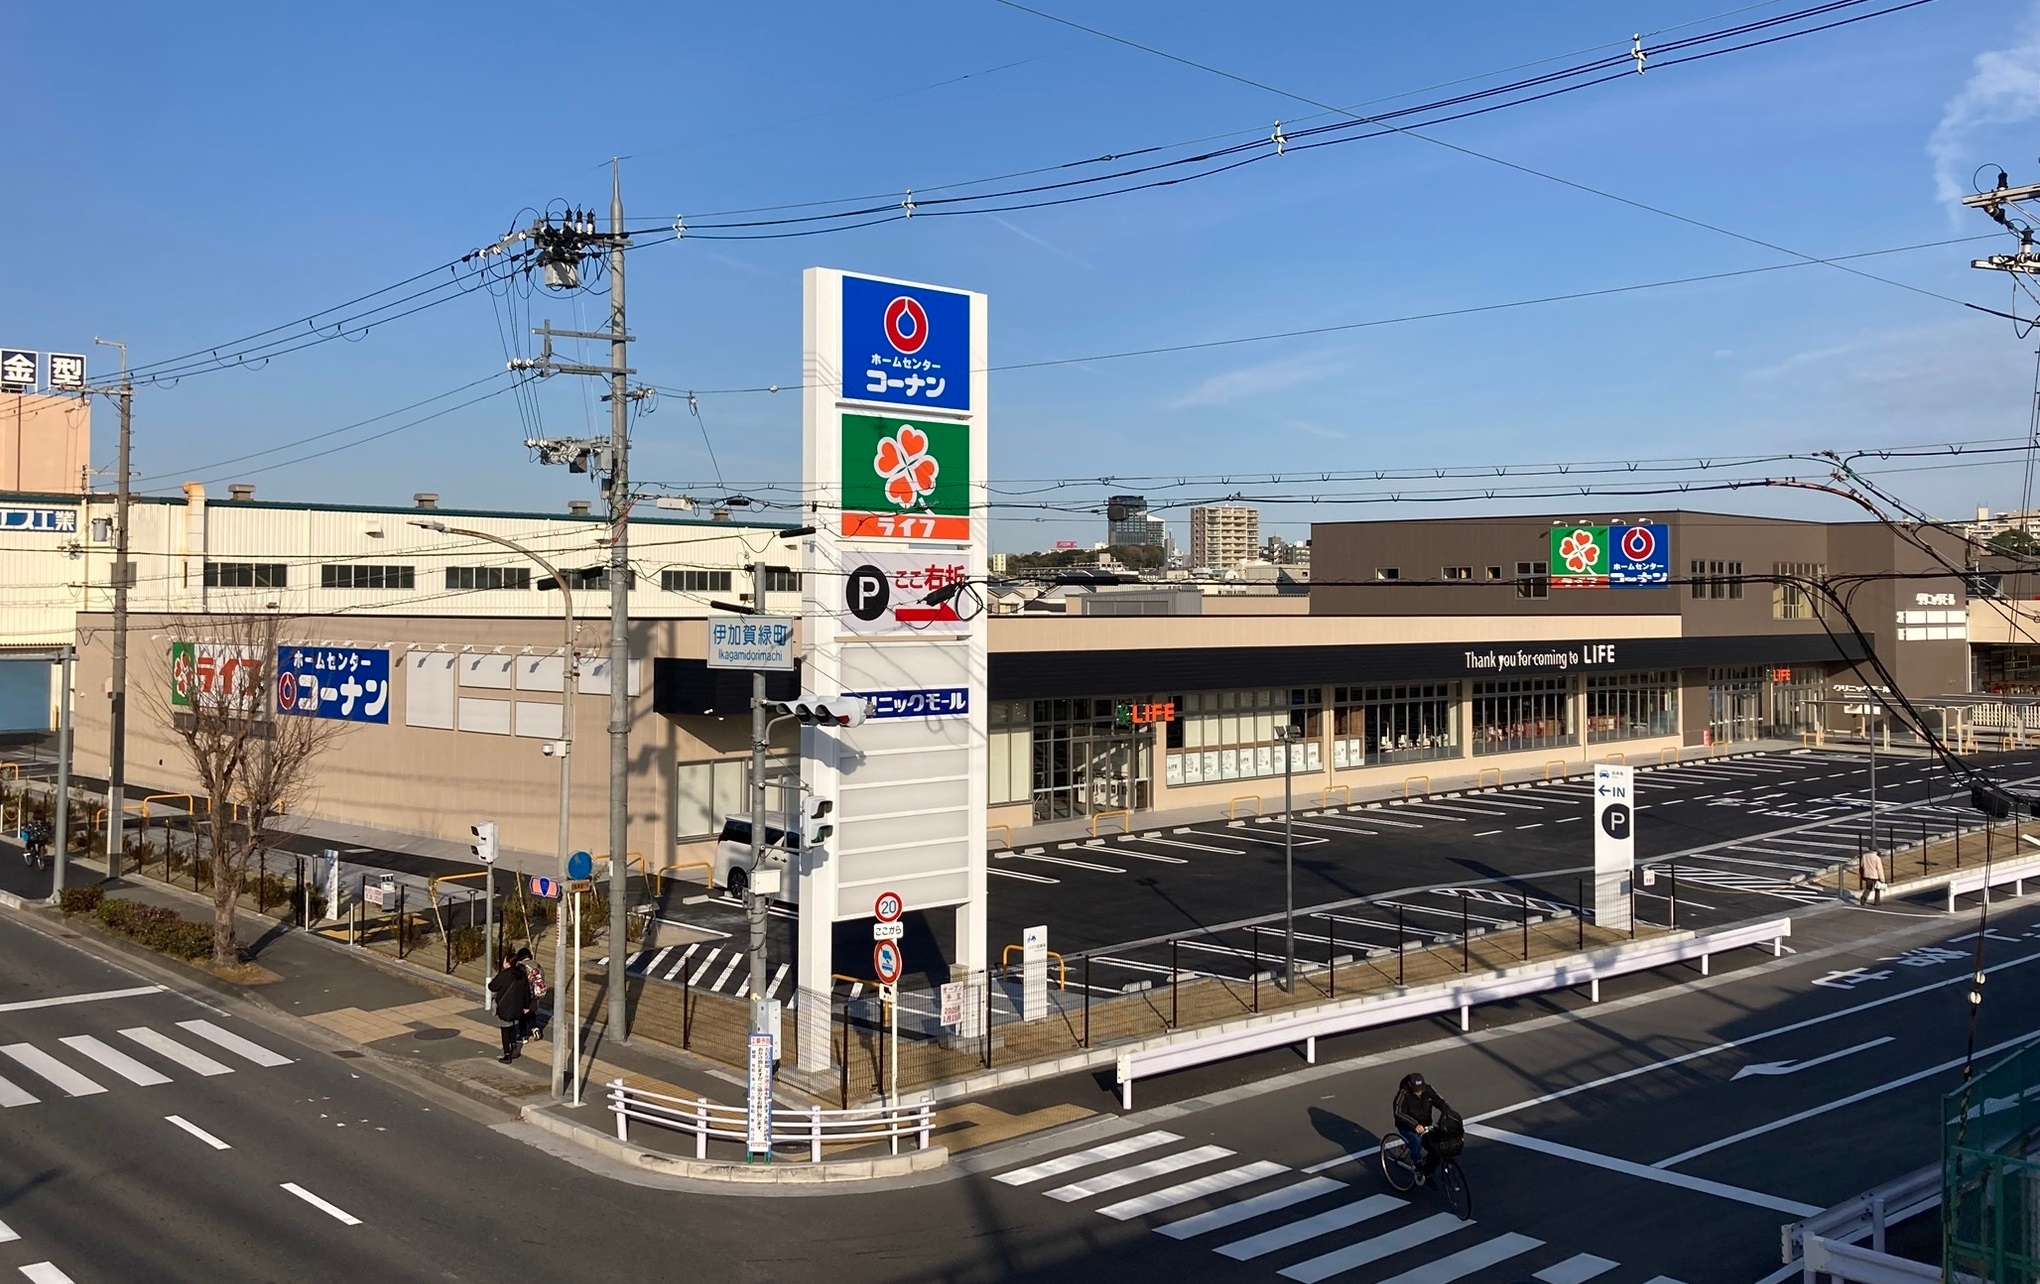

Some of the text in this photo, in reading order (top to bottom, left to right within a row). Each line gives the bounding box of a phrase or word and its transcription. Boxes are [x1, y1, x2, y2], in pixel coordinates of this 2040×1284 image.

[3, 353, 81, 386] 金型
[871, 353, 941, 371] ホームセンター
[866, 370, 946, 398] コーナン
[877, 517, 936, 537] ライフ
[1613, 562, 1664, 571] ホームセンター
[895, 564, 966, 590] ここ右折
[1610, 572, 1668, 587] コーナン
[858, 576, 880, 611] P
[713, 624, 788, 646] 伊加賀緑町
[293, 650, 372, 671] ホームセンター
[718, 649, 783, 662] Ikagamidorimachi
[1465, 644, 1615, 672] Thank you for coming to LIFE
[197, 657, 263, 697] ライフ
[1773, 669, 1791, 682] LIFE
[297, 675, 388, 716] コーナン
[866, 692, 966, 713] リニックモール
[1132, 703, 1175, 723] LIFE
[1612, 786, 1625, 797] IN
[1610, 812, 1625, 831] P
[881, 900, 897, 914] 20
[875, 925, 902, 937] ここから
